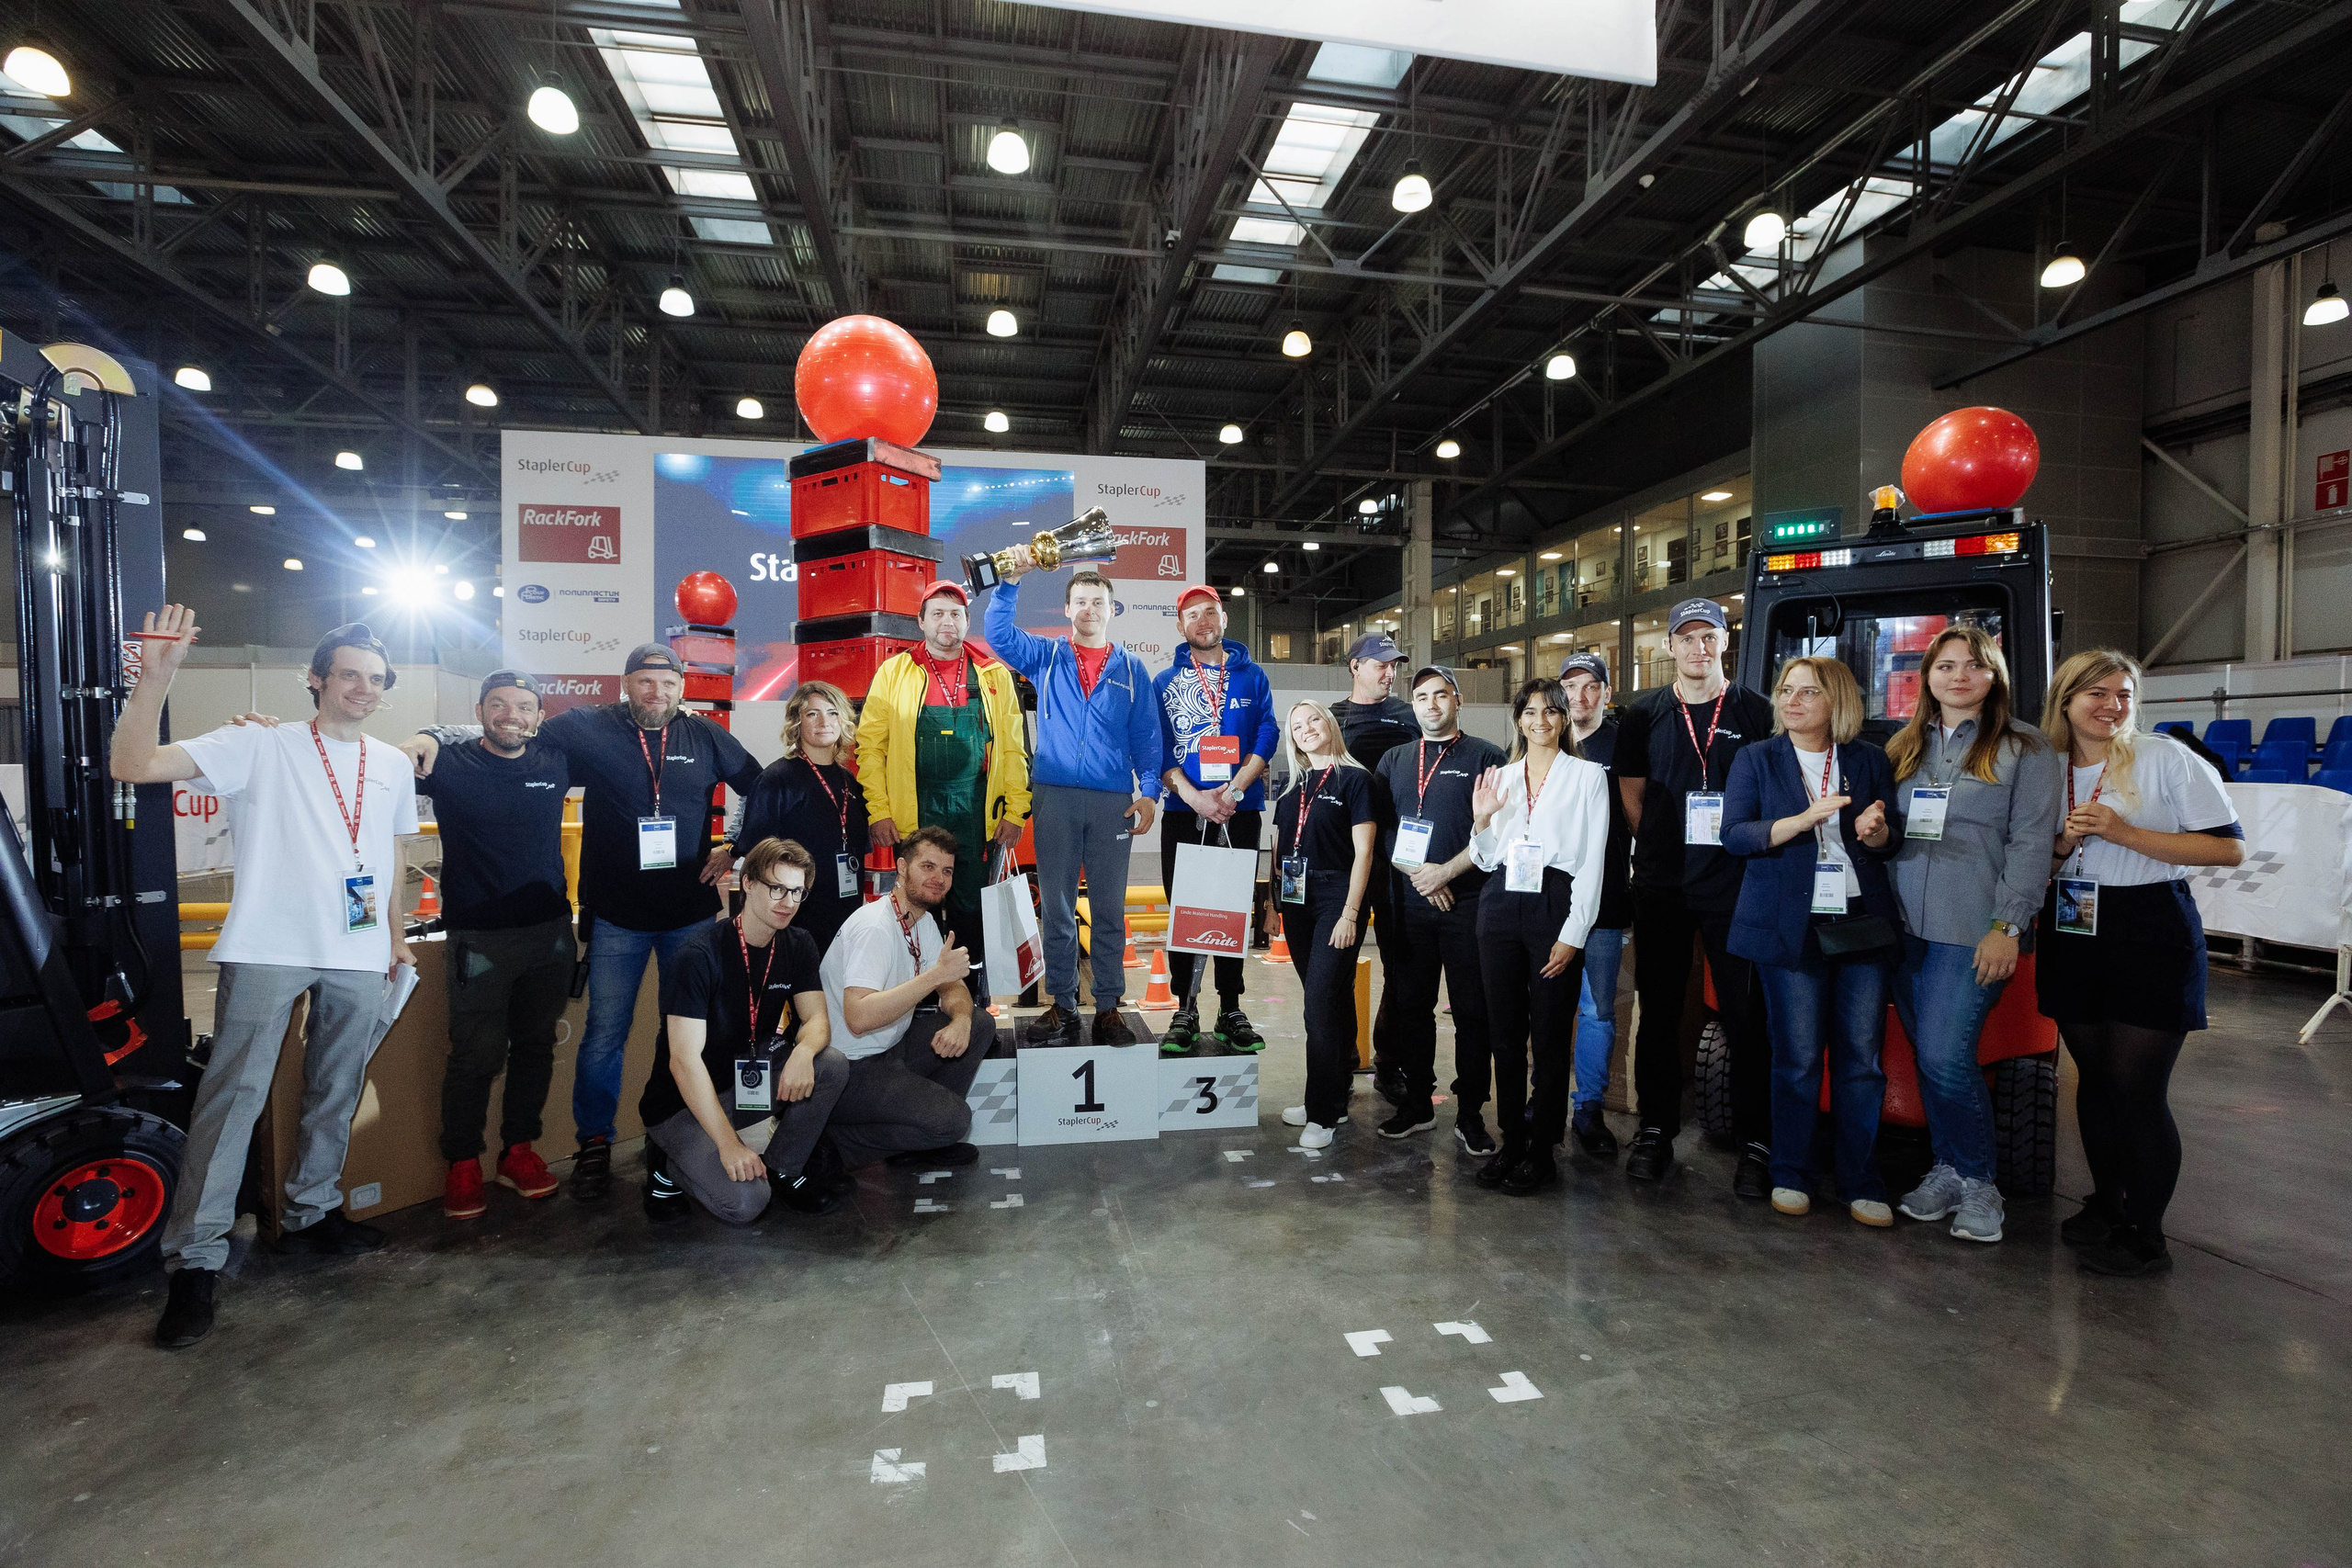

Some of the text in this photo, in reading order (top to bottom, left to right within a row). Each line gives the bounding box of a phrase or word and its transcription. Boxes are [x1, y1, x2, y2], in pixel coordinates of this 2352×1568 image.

[518, 458, 591, 475] StaplerCup
[1097, 483, 1161, 499] StaplerCup
[523, 509, 602, 526] RackFork
[1679, 607, 1711, 617] StaplerCup
[518, 628, 592, 644] StaplerCup
[173, 789, 219, 823] Cup
[1185, 930, 1238, 947] Linde
[1071, 1059, 1105, 1113] 1
[1195, 1077, 1218, 1114] 3
[1057, 1116, 1102, 1127] StaplerCup
